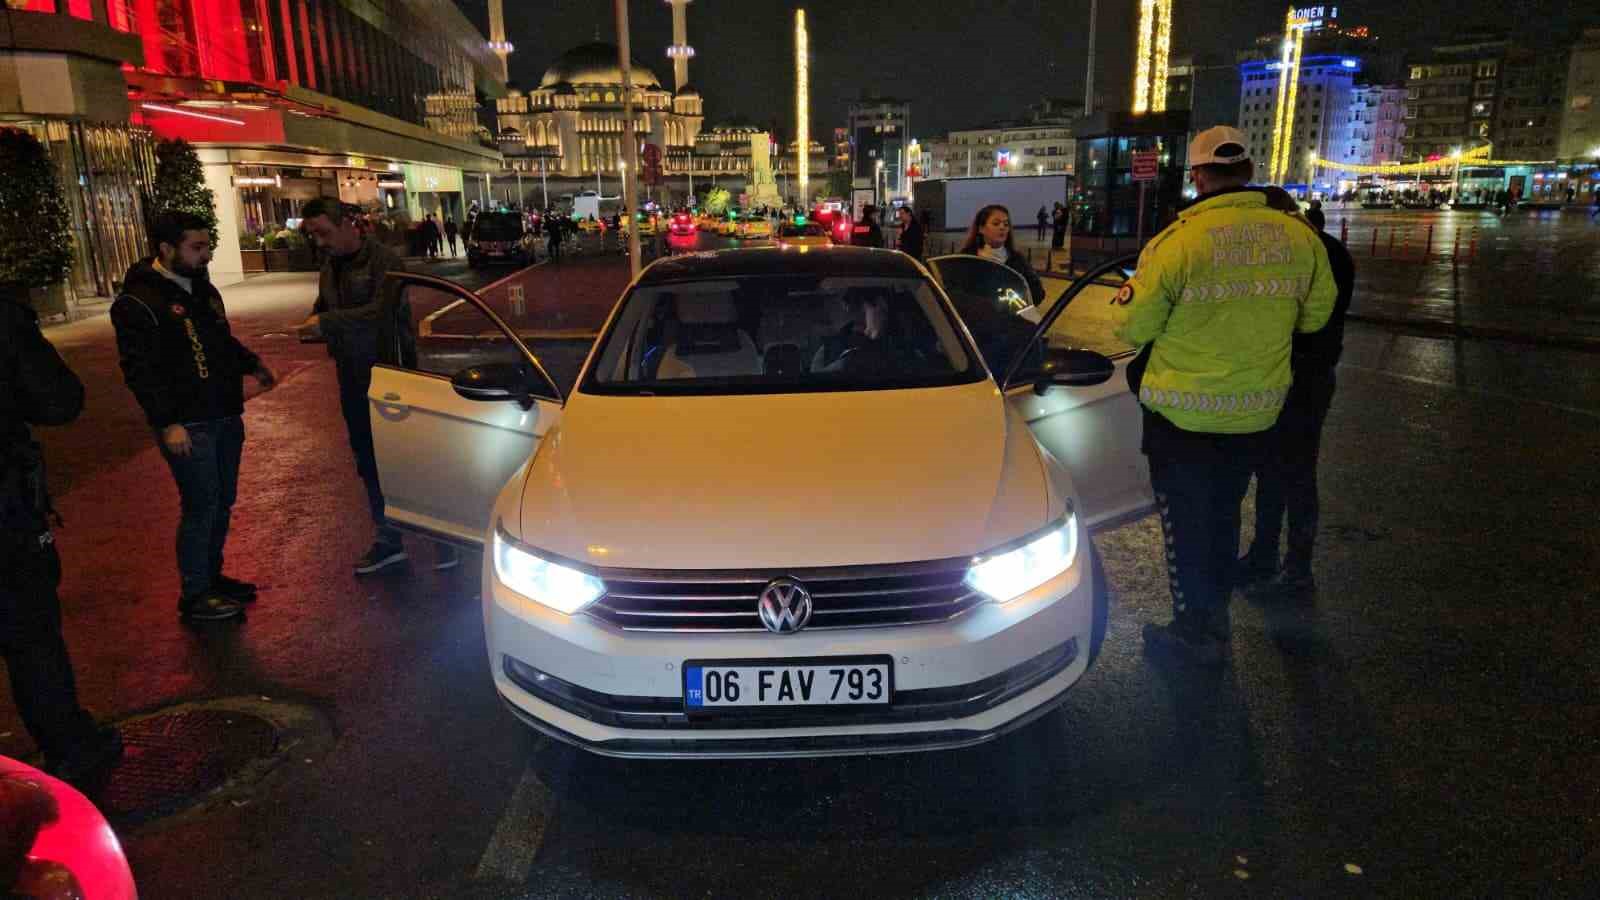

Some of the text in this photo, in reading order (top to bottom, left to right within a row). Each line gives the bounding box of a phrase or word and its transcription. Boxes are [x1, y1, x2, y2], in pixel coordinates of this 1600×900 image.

[688, 690, 702, 700] TR
[705, 668, 883, 703] 06 FAV 793
